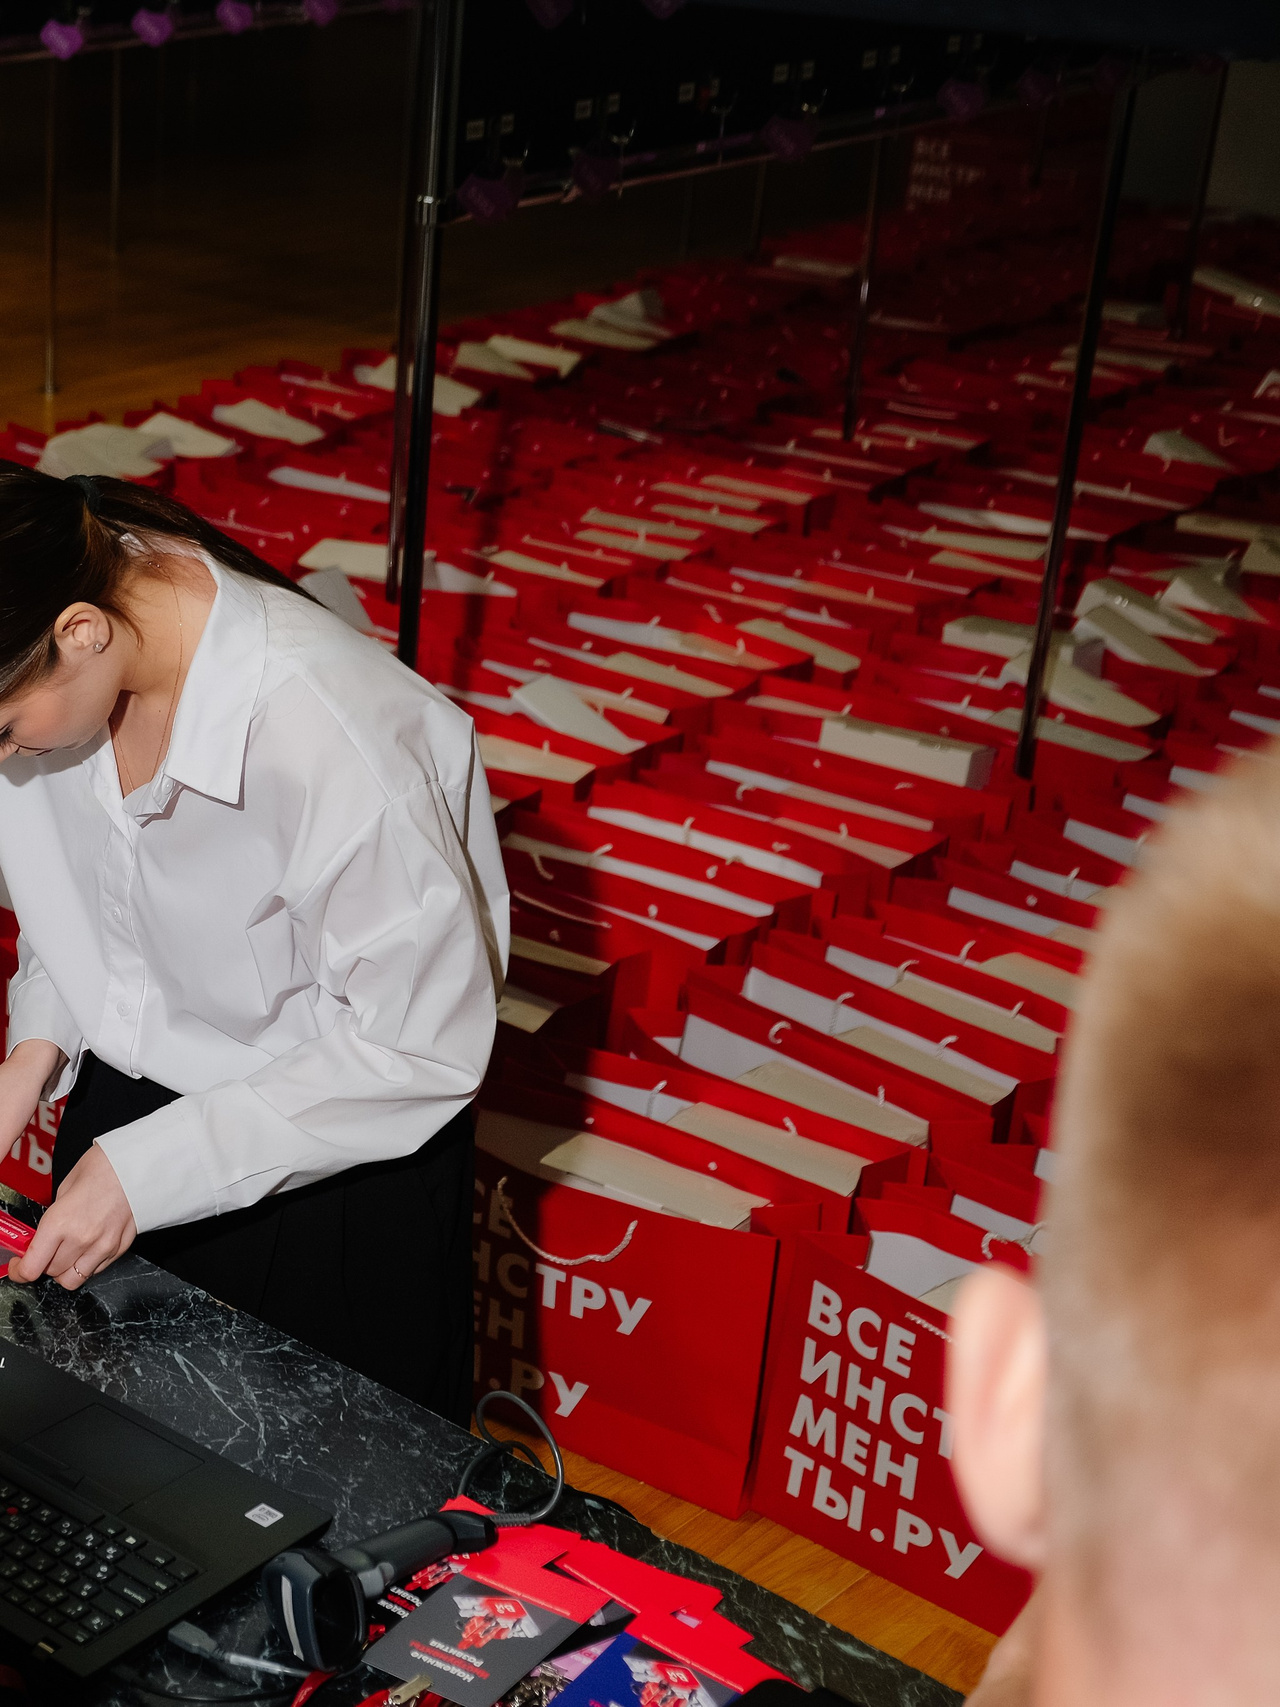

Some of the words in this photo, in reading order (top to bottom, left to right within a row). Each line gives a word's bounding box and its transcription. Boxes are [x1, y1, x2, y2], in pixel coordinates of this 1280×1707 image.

[807, 1279, 917, 1379] ВСЕ
[788, 1394, 920, 1501] МЕН
[783, 1446, 984, 1580] ТЫ.РУ
[410, 1650, 475, 1683] Надежные
[428, 1639, 484, 1668] Развития
